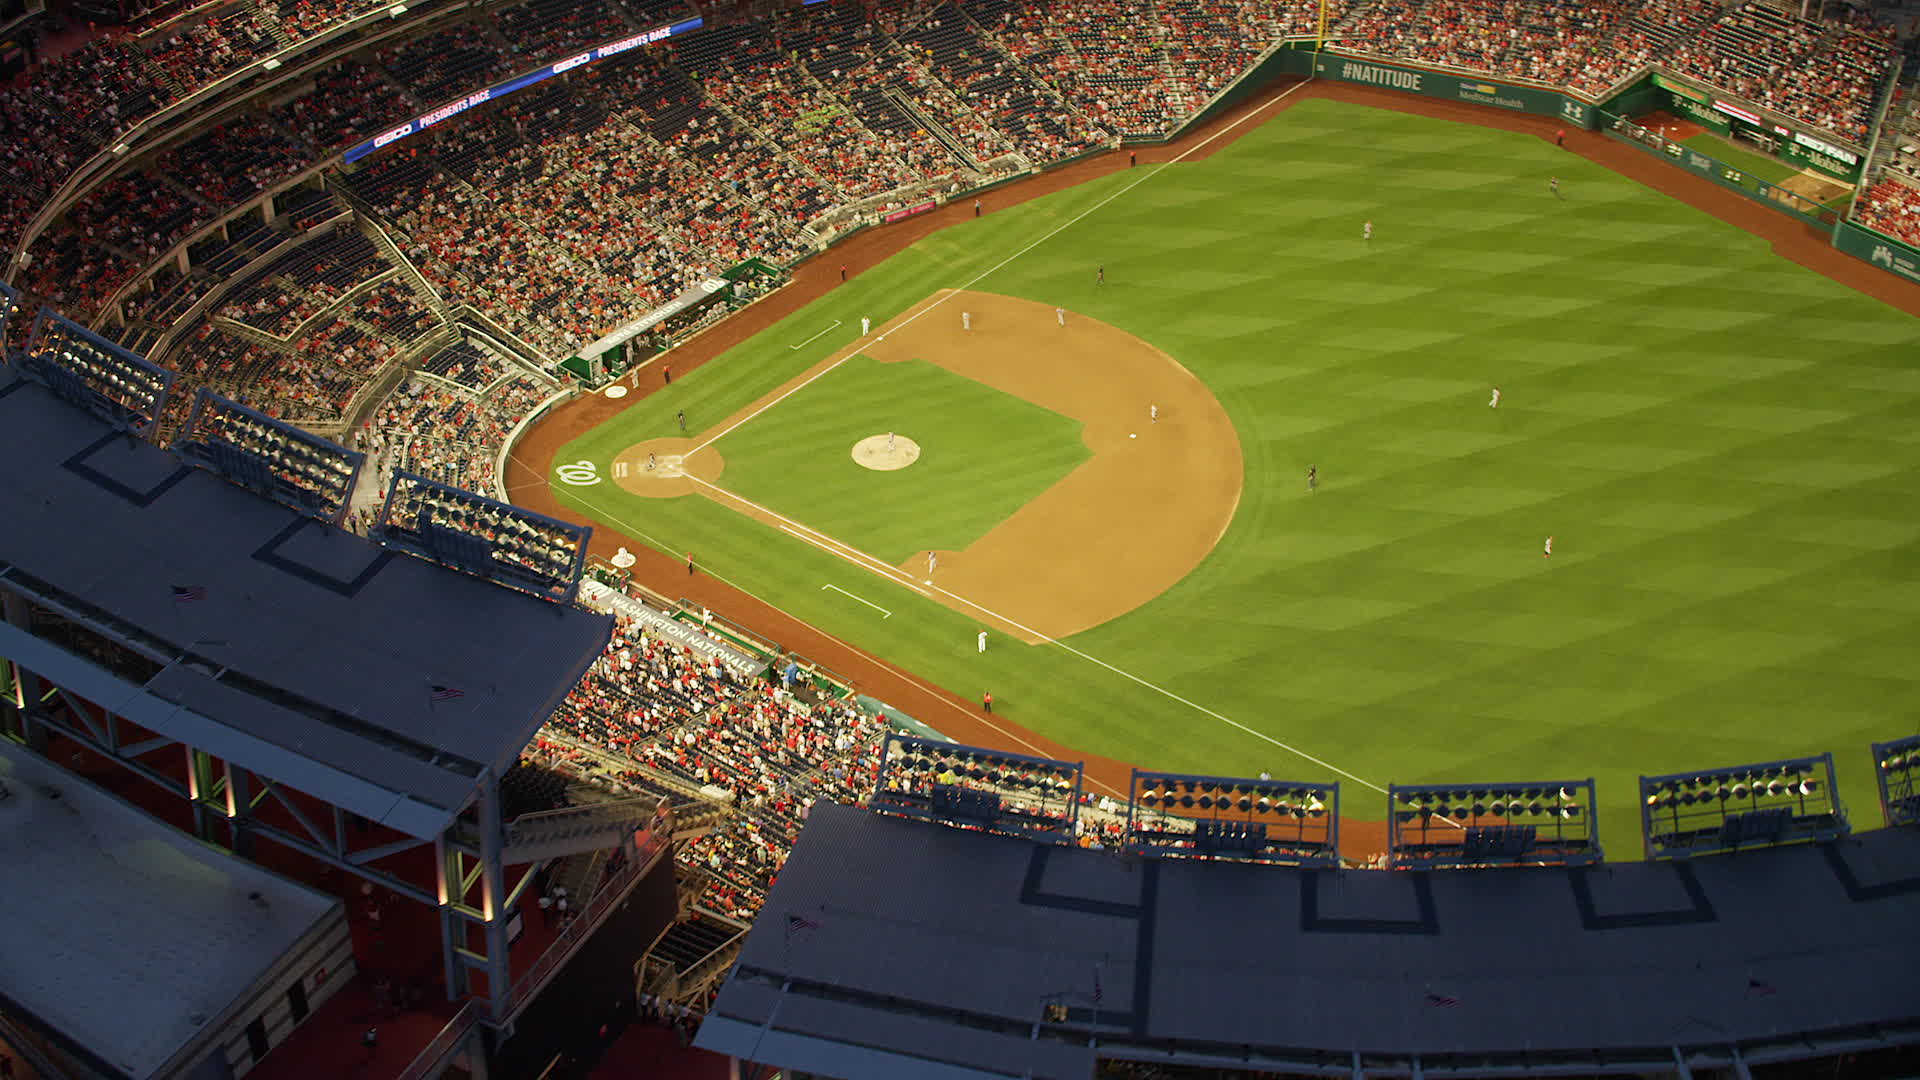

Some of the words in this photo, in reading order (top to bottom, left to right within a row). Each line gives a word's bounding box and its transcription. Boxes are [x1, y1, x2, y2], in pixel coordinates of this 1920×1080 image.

[553, 53, 590, 74] GEICO
[597, 33, 649, 58] PRESIDENTS
[649, 26, 672, 43] RACE
[1342, 62, 1422, 91] #NATITUDE
[374, 123, 412, 148] GEICO
[419, 99, 468, 129] PRESIDENTS
[469, 89, 491, 109] RACE
[609, 596, 689, 639] WASHINGTON
[687, 634, 756, 674] NATIONALS
